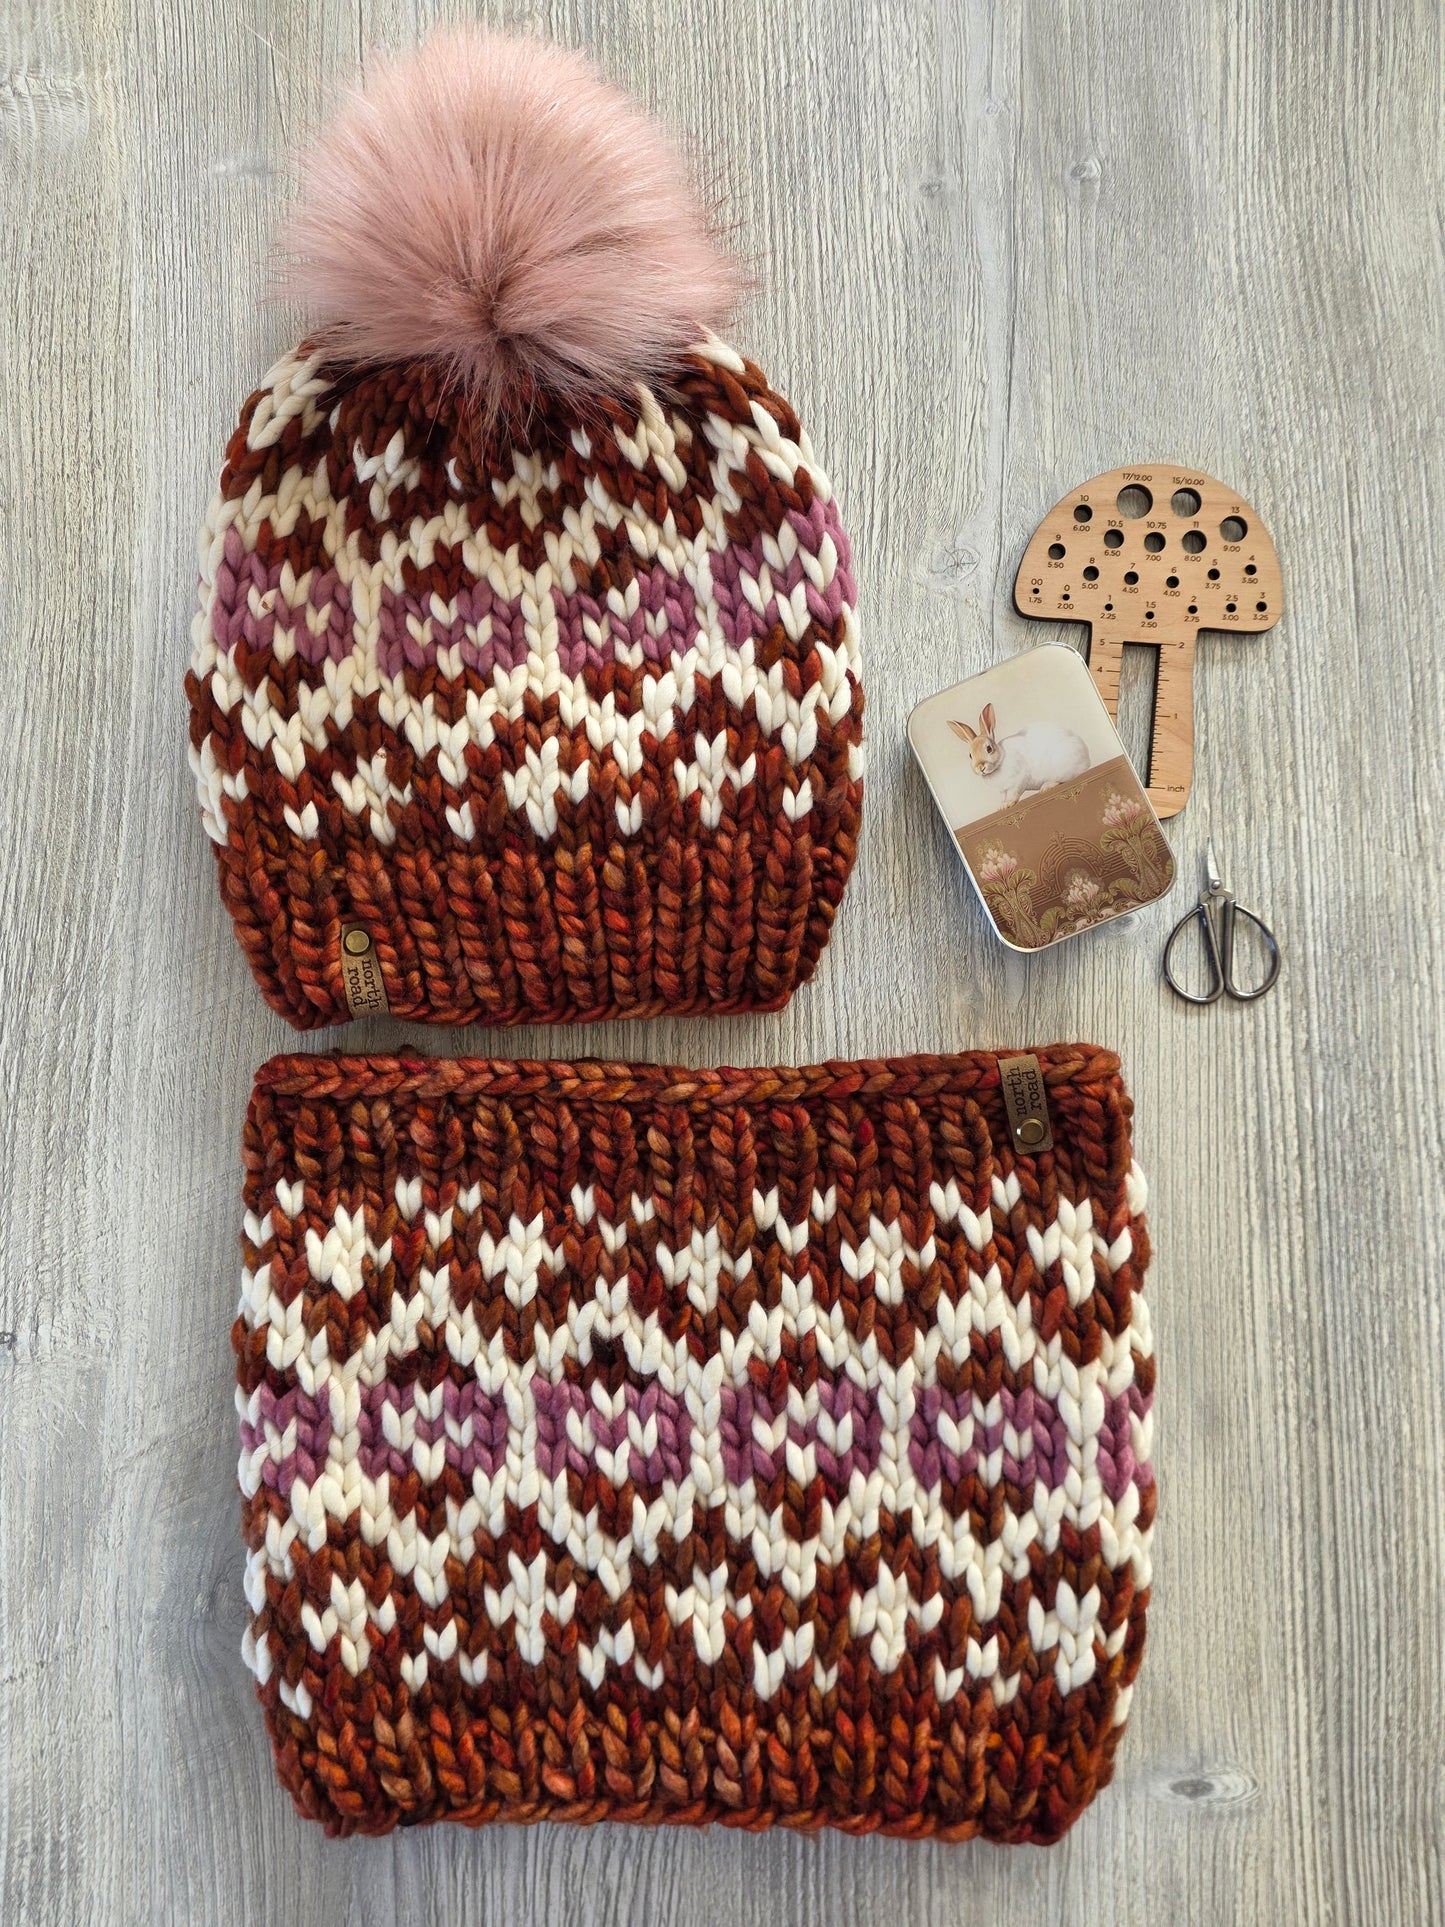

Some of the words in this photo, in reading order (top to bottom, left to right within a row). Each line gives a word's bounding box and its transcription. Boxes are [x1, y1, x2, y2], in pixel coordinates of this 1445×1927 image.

[1122, 473, 1152, 482] 17/12.00
[1173, 477, 1204, 486] 15/10.00
[1107, 520, 1123, 528] 10.5
[1163, 590, 1180, 598] 4.00
[1222, 614, 1239, 622] 3.00
[347, 967, 367, 1007] road
[362, 959, 382, 1009] north
[1007, 1066, 1027, 1116] north
[1022, 1069, 1042, 1111] road
